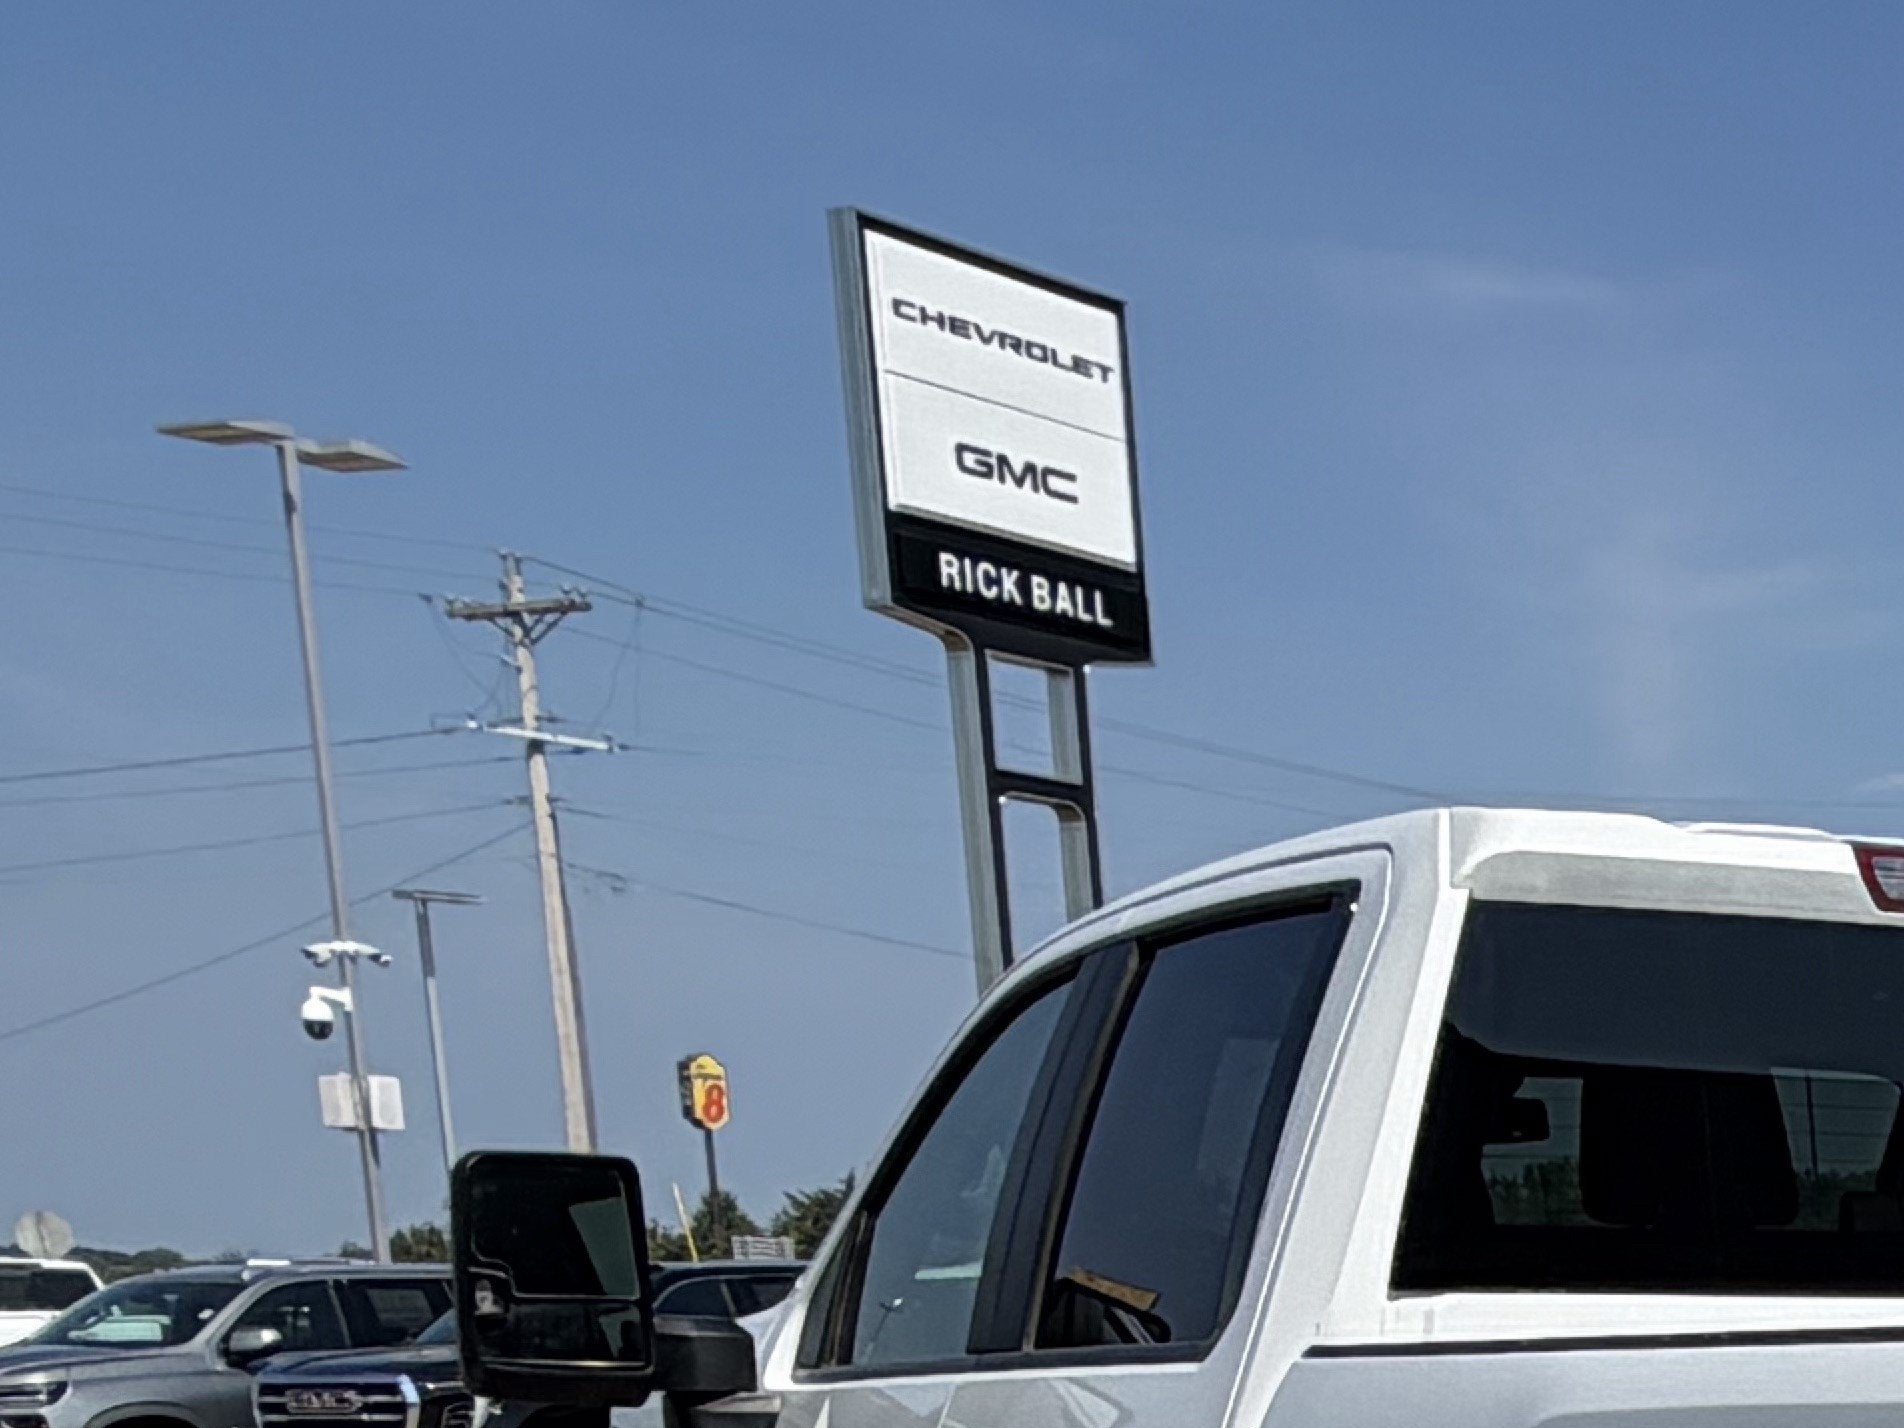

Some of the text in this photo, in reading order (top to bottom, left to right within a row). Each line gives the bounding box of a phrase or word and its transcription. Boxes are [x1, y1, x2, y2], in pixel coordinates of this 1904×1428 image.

[892, 297, 1115, 384] CHEVROLET
[955, 442, 1079, 504] GMC
[939, 551, 1114, 627] RICK BALL
[703, 1083, 724, 1124] 8
